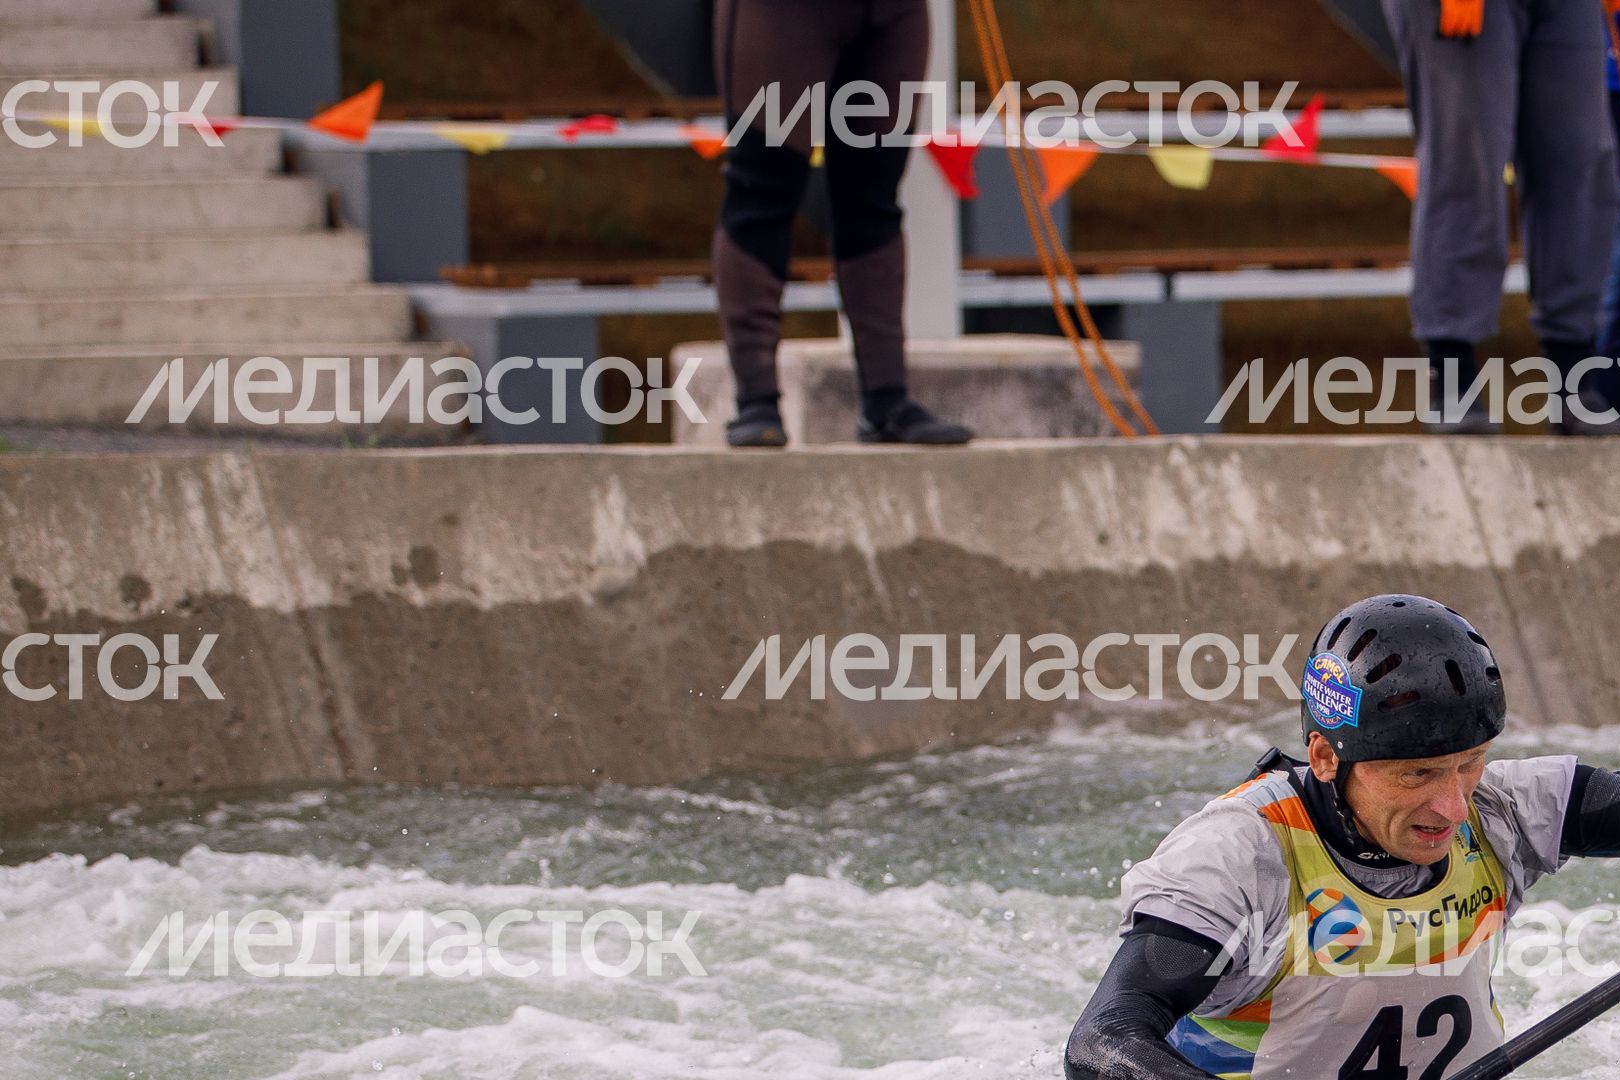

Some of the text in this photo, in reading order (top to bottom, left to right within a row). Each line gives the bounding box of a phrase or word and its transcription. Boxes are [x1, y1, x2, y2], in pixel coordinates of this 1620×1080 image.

[1314, 658, 1345, 684] CAMEL
[1304, 680, 1354, 717] CHALLENGE
[1386, 885, 1493, 937] РусГидро
